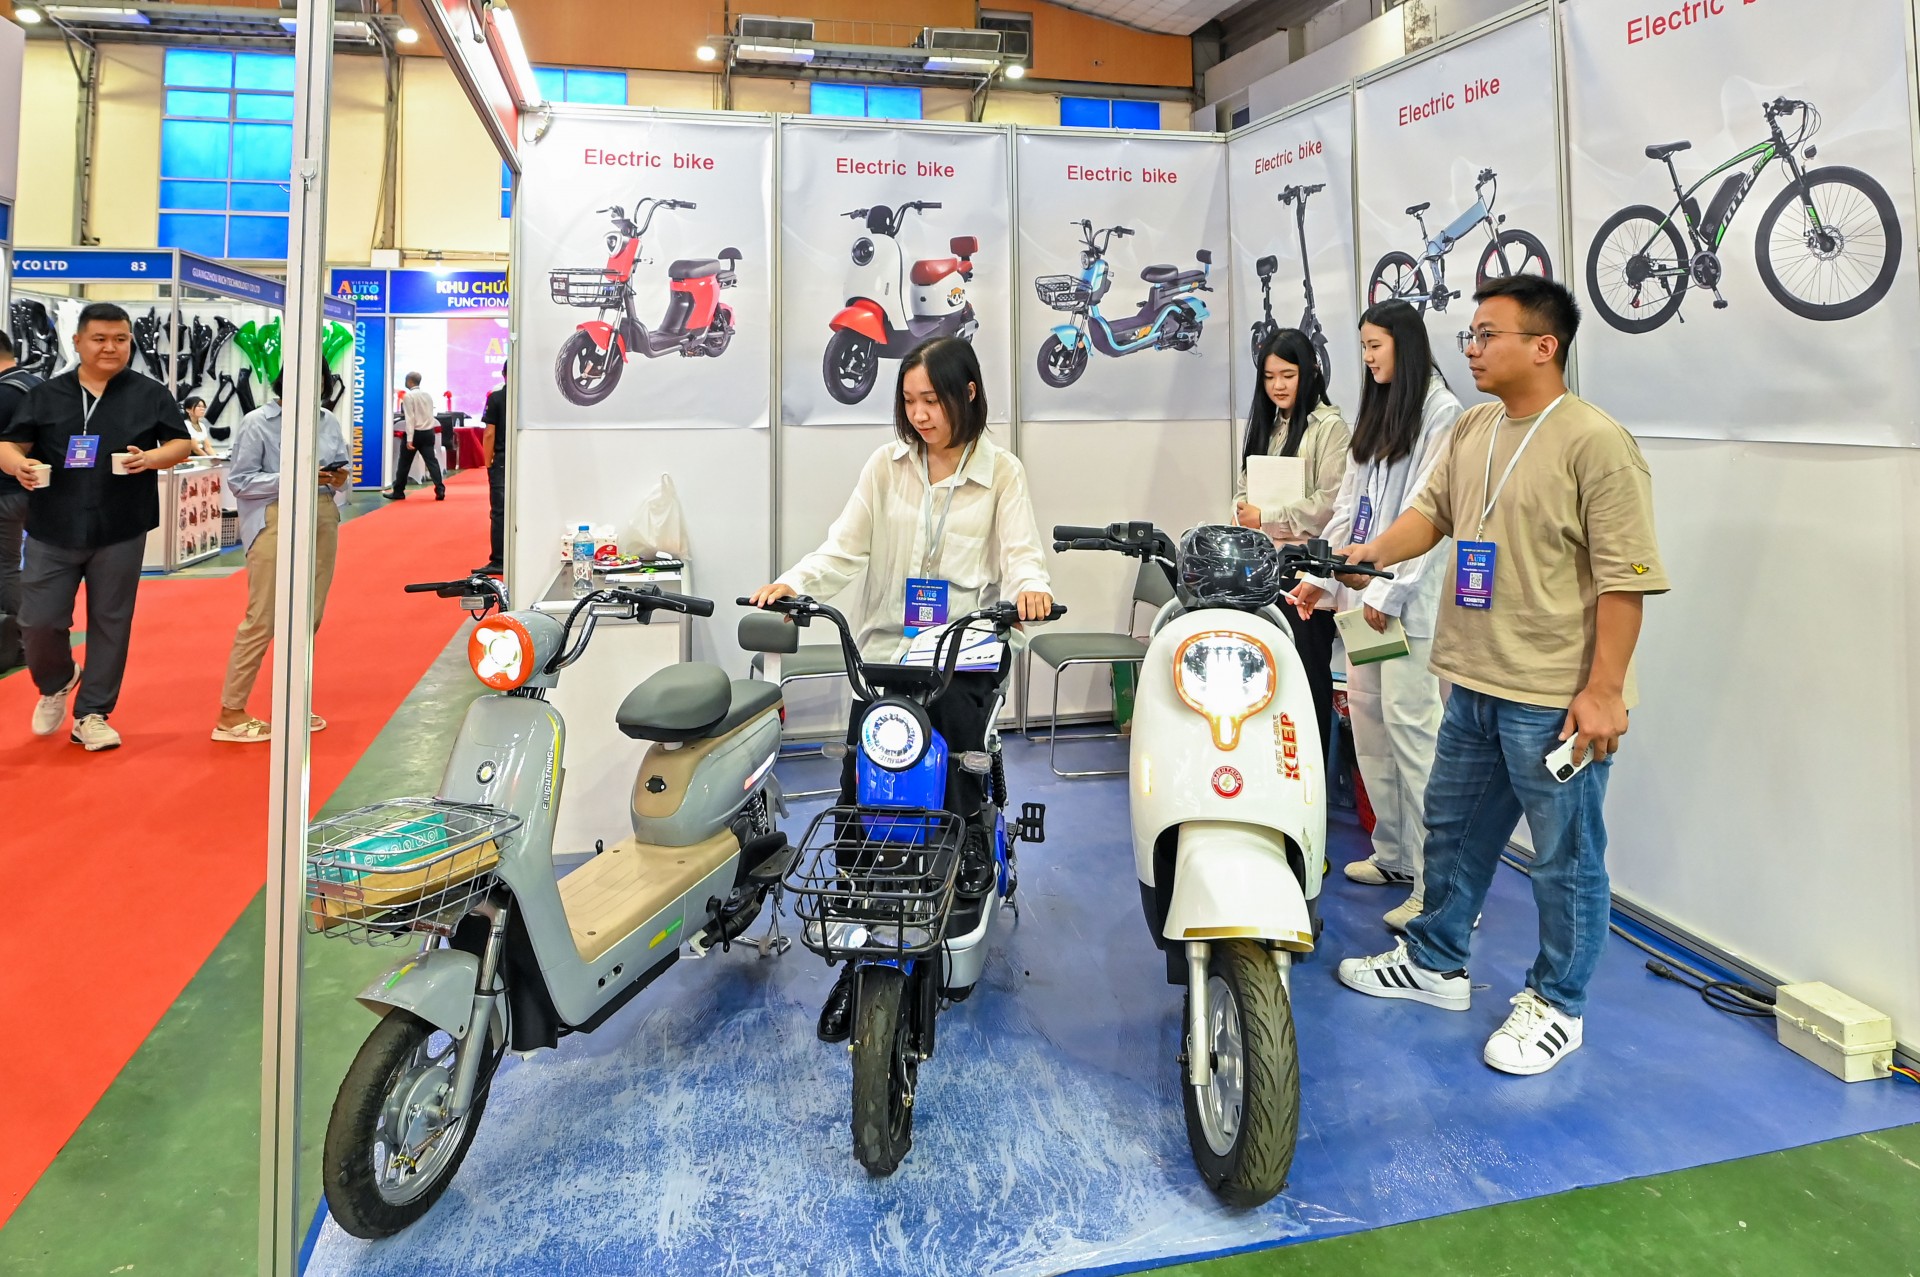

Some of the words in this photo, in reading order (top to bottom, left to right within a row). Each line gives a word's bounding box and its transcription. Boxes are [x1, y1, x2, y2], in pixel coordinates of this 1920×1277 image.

[1626, 0, 1726, 45] Electric
[1399, 93, 1455, 127] Electric
[1464, 78, 1501, 104] bike
[584, 148, 660, 168] Electric
[673, 153, 715, 171] bike
[836, 157, 907, 176] Electric
[917, 161, 955, 178] bike
[1254, 148, 1294, 175] Electric
[1299, 140, 1323, 160] bike
[1067, 164, 1133, 183] Electric
[1142, 168, 1178, 184] bike
[22, 260, 41, 270] CO
[43, 260, 69, 271] LTD
[130, 261, 148, 272] 83
[337, 280, 379, 294] AUTO
[436, 280, 469, 294] KHU
[355, 321, 366, 353] 2025
[353, 355, 366, 423] AUTOEXPO
[352, 426, 363, 485] VIETNAM
[1280, 711, 1300, 781] KEEP
[543, 751, 554, 801] LIGHTNING
